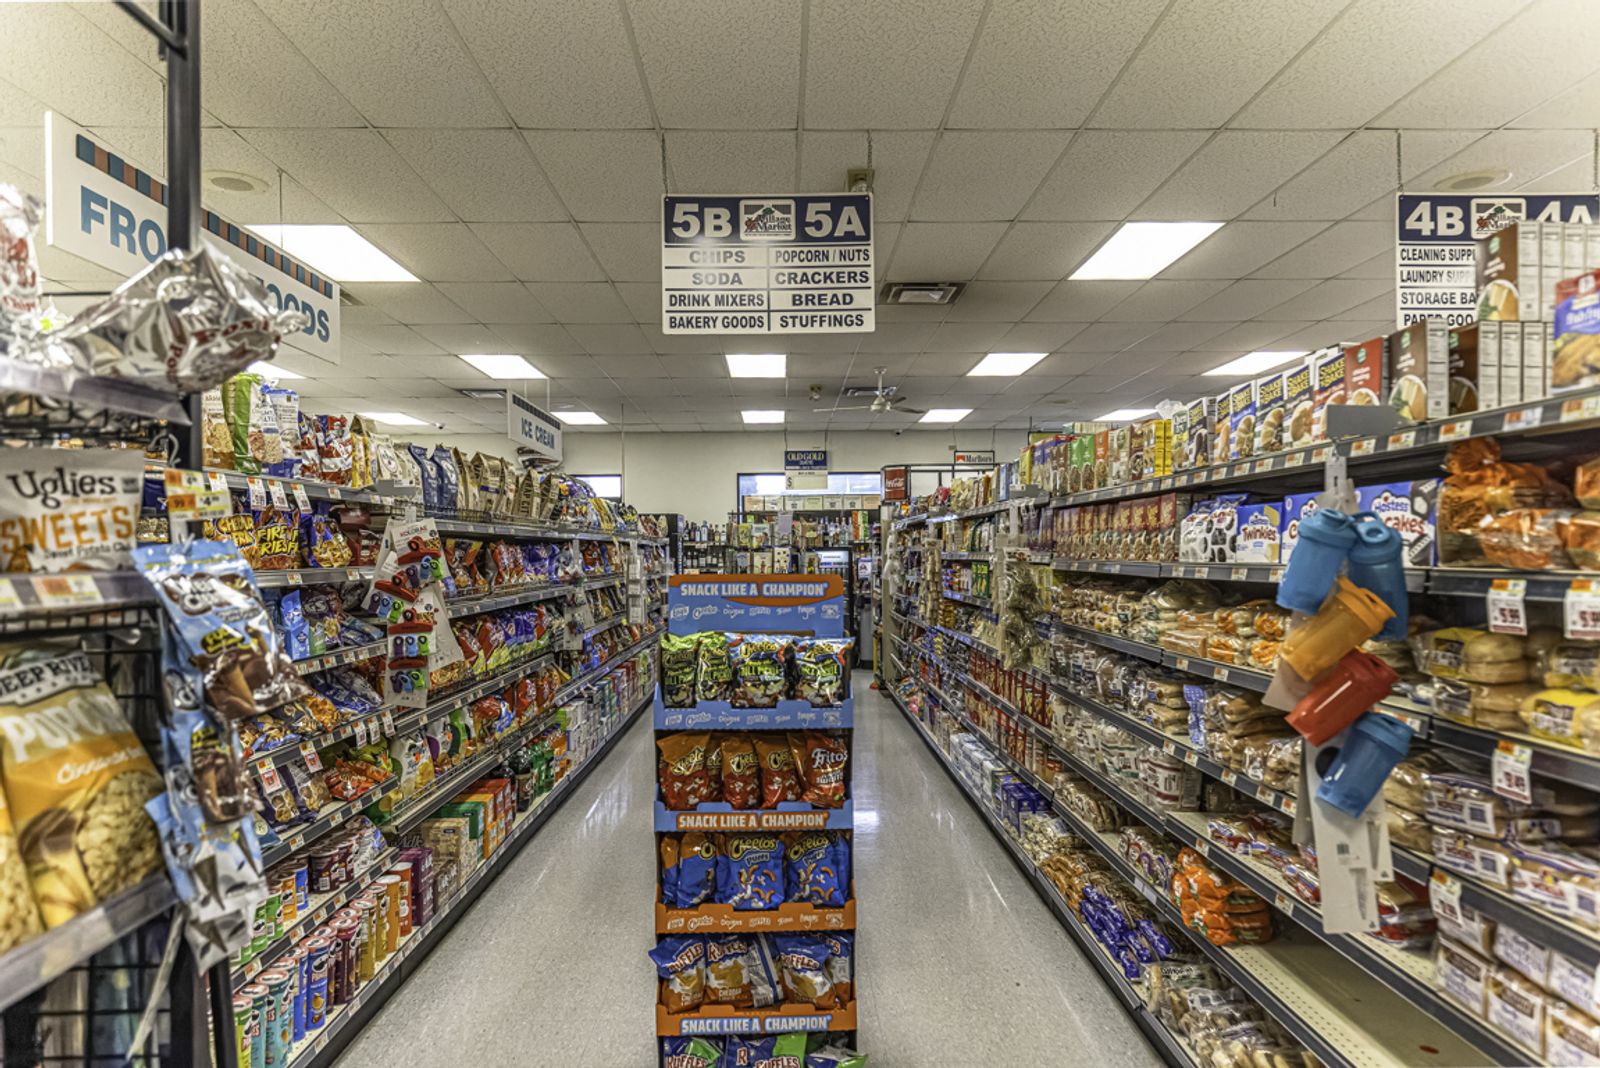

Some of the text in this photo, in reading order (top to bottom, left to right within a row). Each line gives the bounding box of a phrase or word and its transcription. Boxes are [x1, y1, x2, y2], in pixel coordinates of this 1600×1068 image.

[672, 203, 733, 238] 5B
[757, 214, 791, 223] Village
[804, 203, 866, 237] 5A
[1405, 201, 1465, 236] 4B
[757, 222, 792, 231] Market
[689, 250, 746, 264] CHIPS
[775, 250, 829, 263] POPCORN
[839, 249, 870, 262] NUTS
[1400, 248, 1446, 261] CLEANING
[692, 272, 743, 286] SODA
[775, 271, 870, 284] CRACKERS
[1400, 270, 1444, 283] LAUNDRY
[669, 294, 764, 307] DRINK MIXERS
[791, 293, 854, 306] BREAD
[1401, 292, 1456, 304] STORAGE
[669, 315, 764, 329] BAKERY GOODS
[779, 314, 864, 328] STUFFINGS
[521, 416, 555, 449] ICE CREAM
[6, 467, 117, 509] Uglies
[1375, 502, 1409, 513] Hostess
[1242, 526, 1277, 541] Twinkies
[681, 583, 824, 596] SNACK LIKE A CHAMPION
[812, 749, 848, 769] Fritos
[679, 813, 824, 828] SNACK LIKE A CHAMPION
[730, 838, 776, 860] Cheetos
[681, 1018, 827, 1033] SNACK LIKE A CHAMPION
